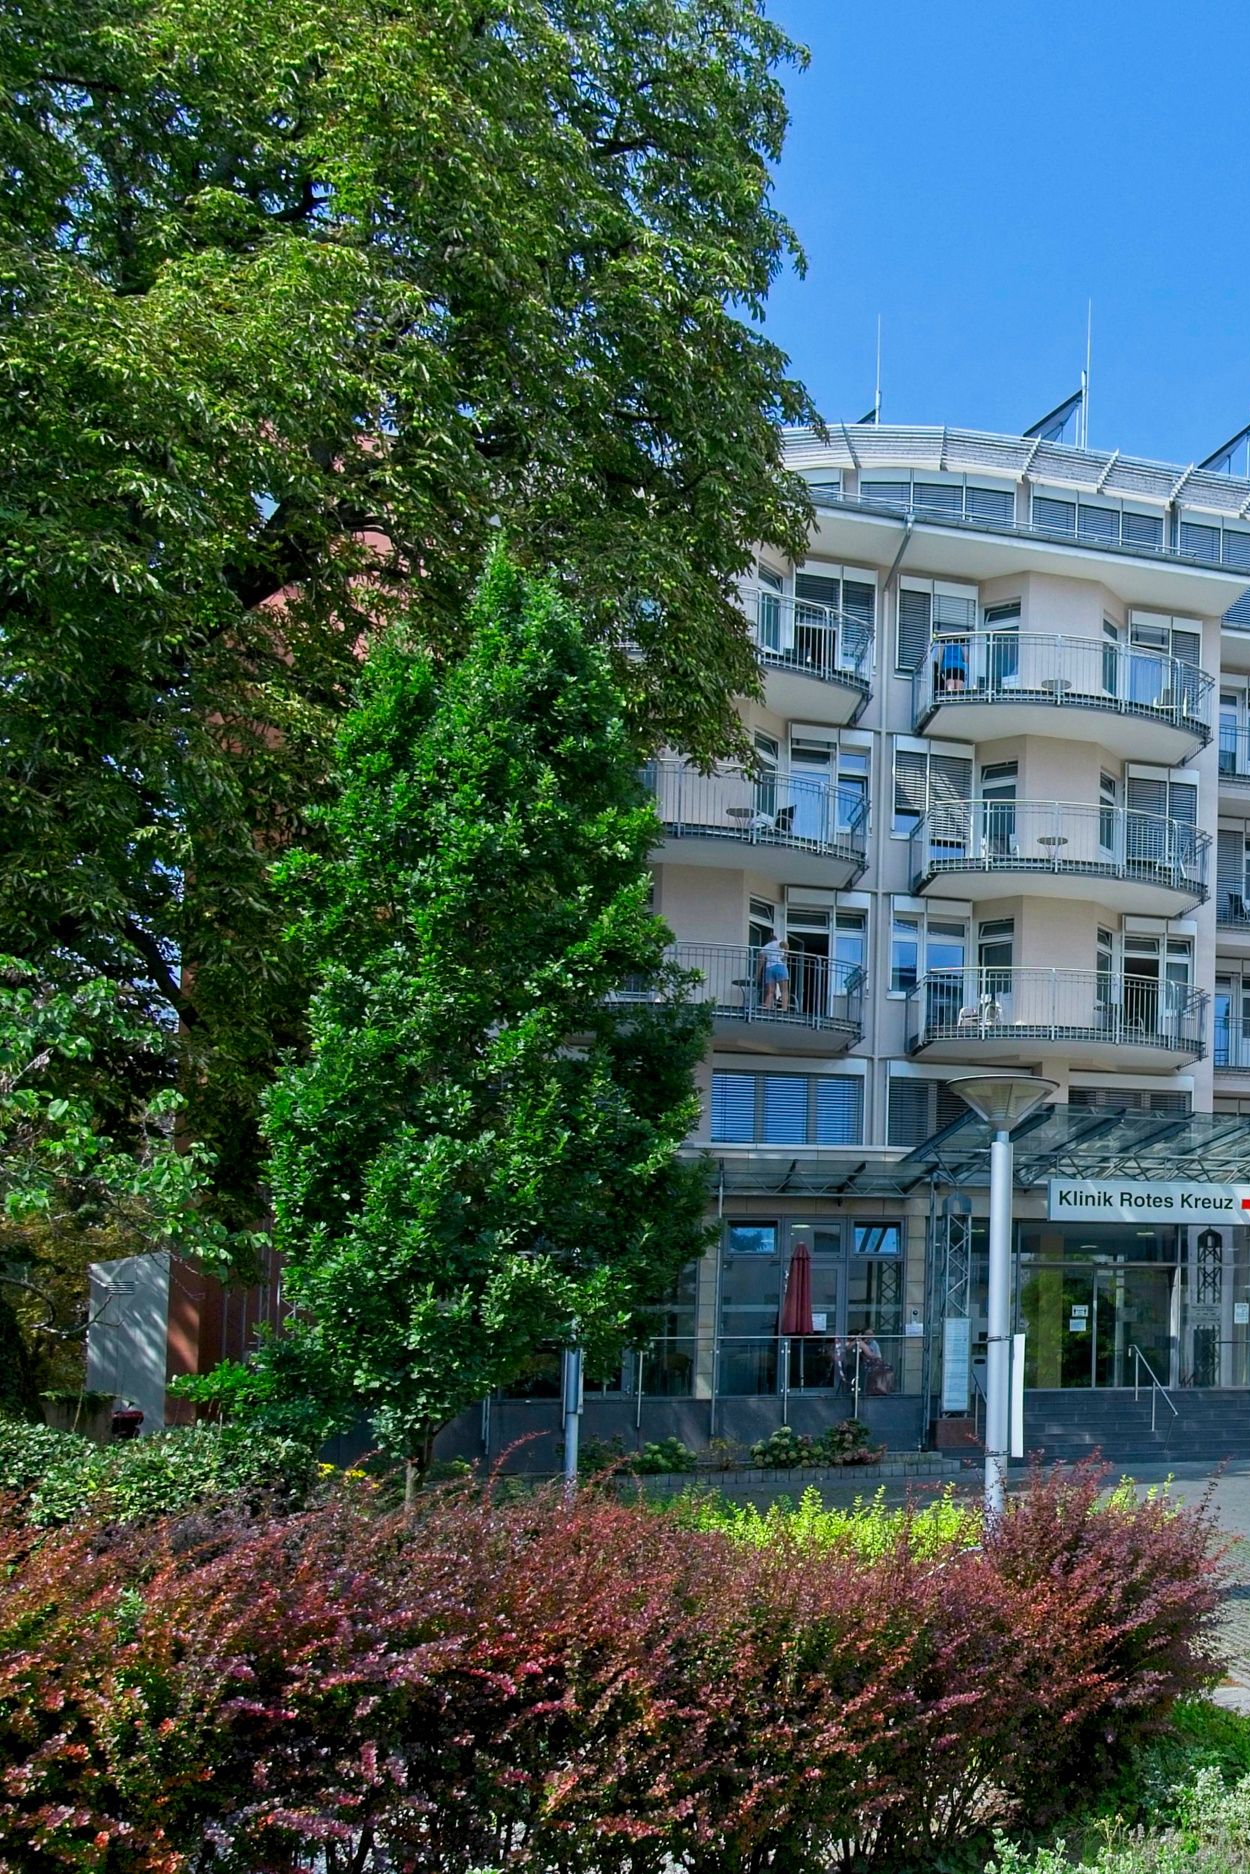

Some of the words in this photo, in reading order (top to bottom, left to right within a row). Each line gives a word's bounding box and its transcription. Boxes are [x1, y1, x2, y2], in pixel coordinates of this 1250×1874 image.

[1059, 1190, 1113, 1207] Klinik
[1120, 1191, 1174, 1208] Rotes
[1180, 1193, 1233, 1210] Kreuz
